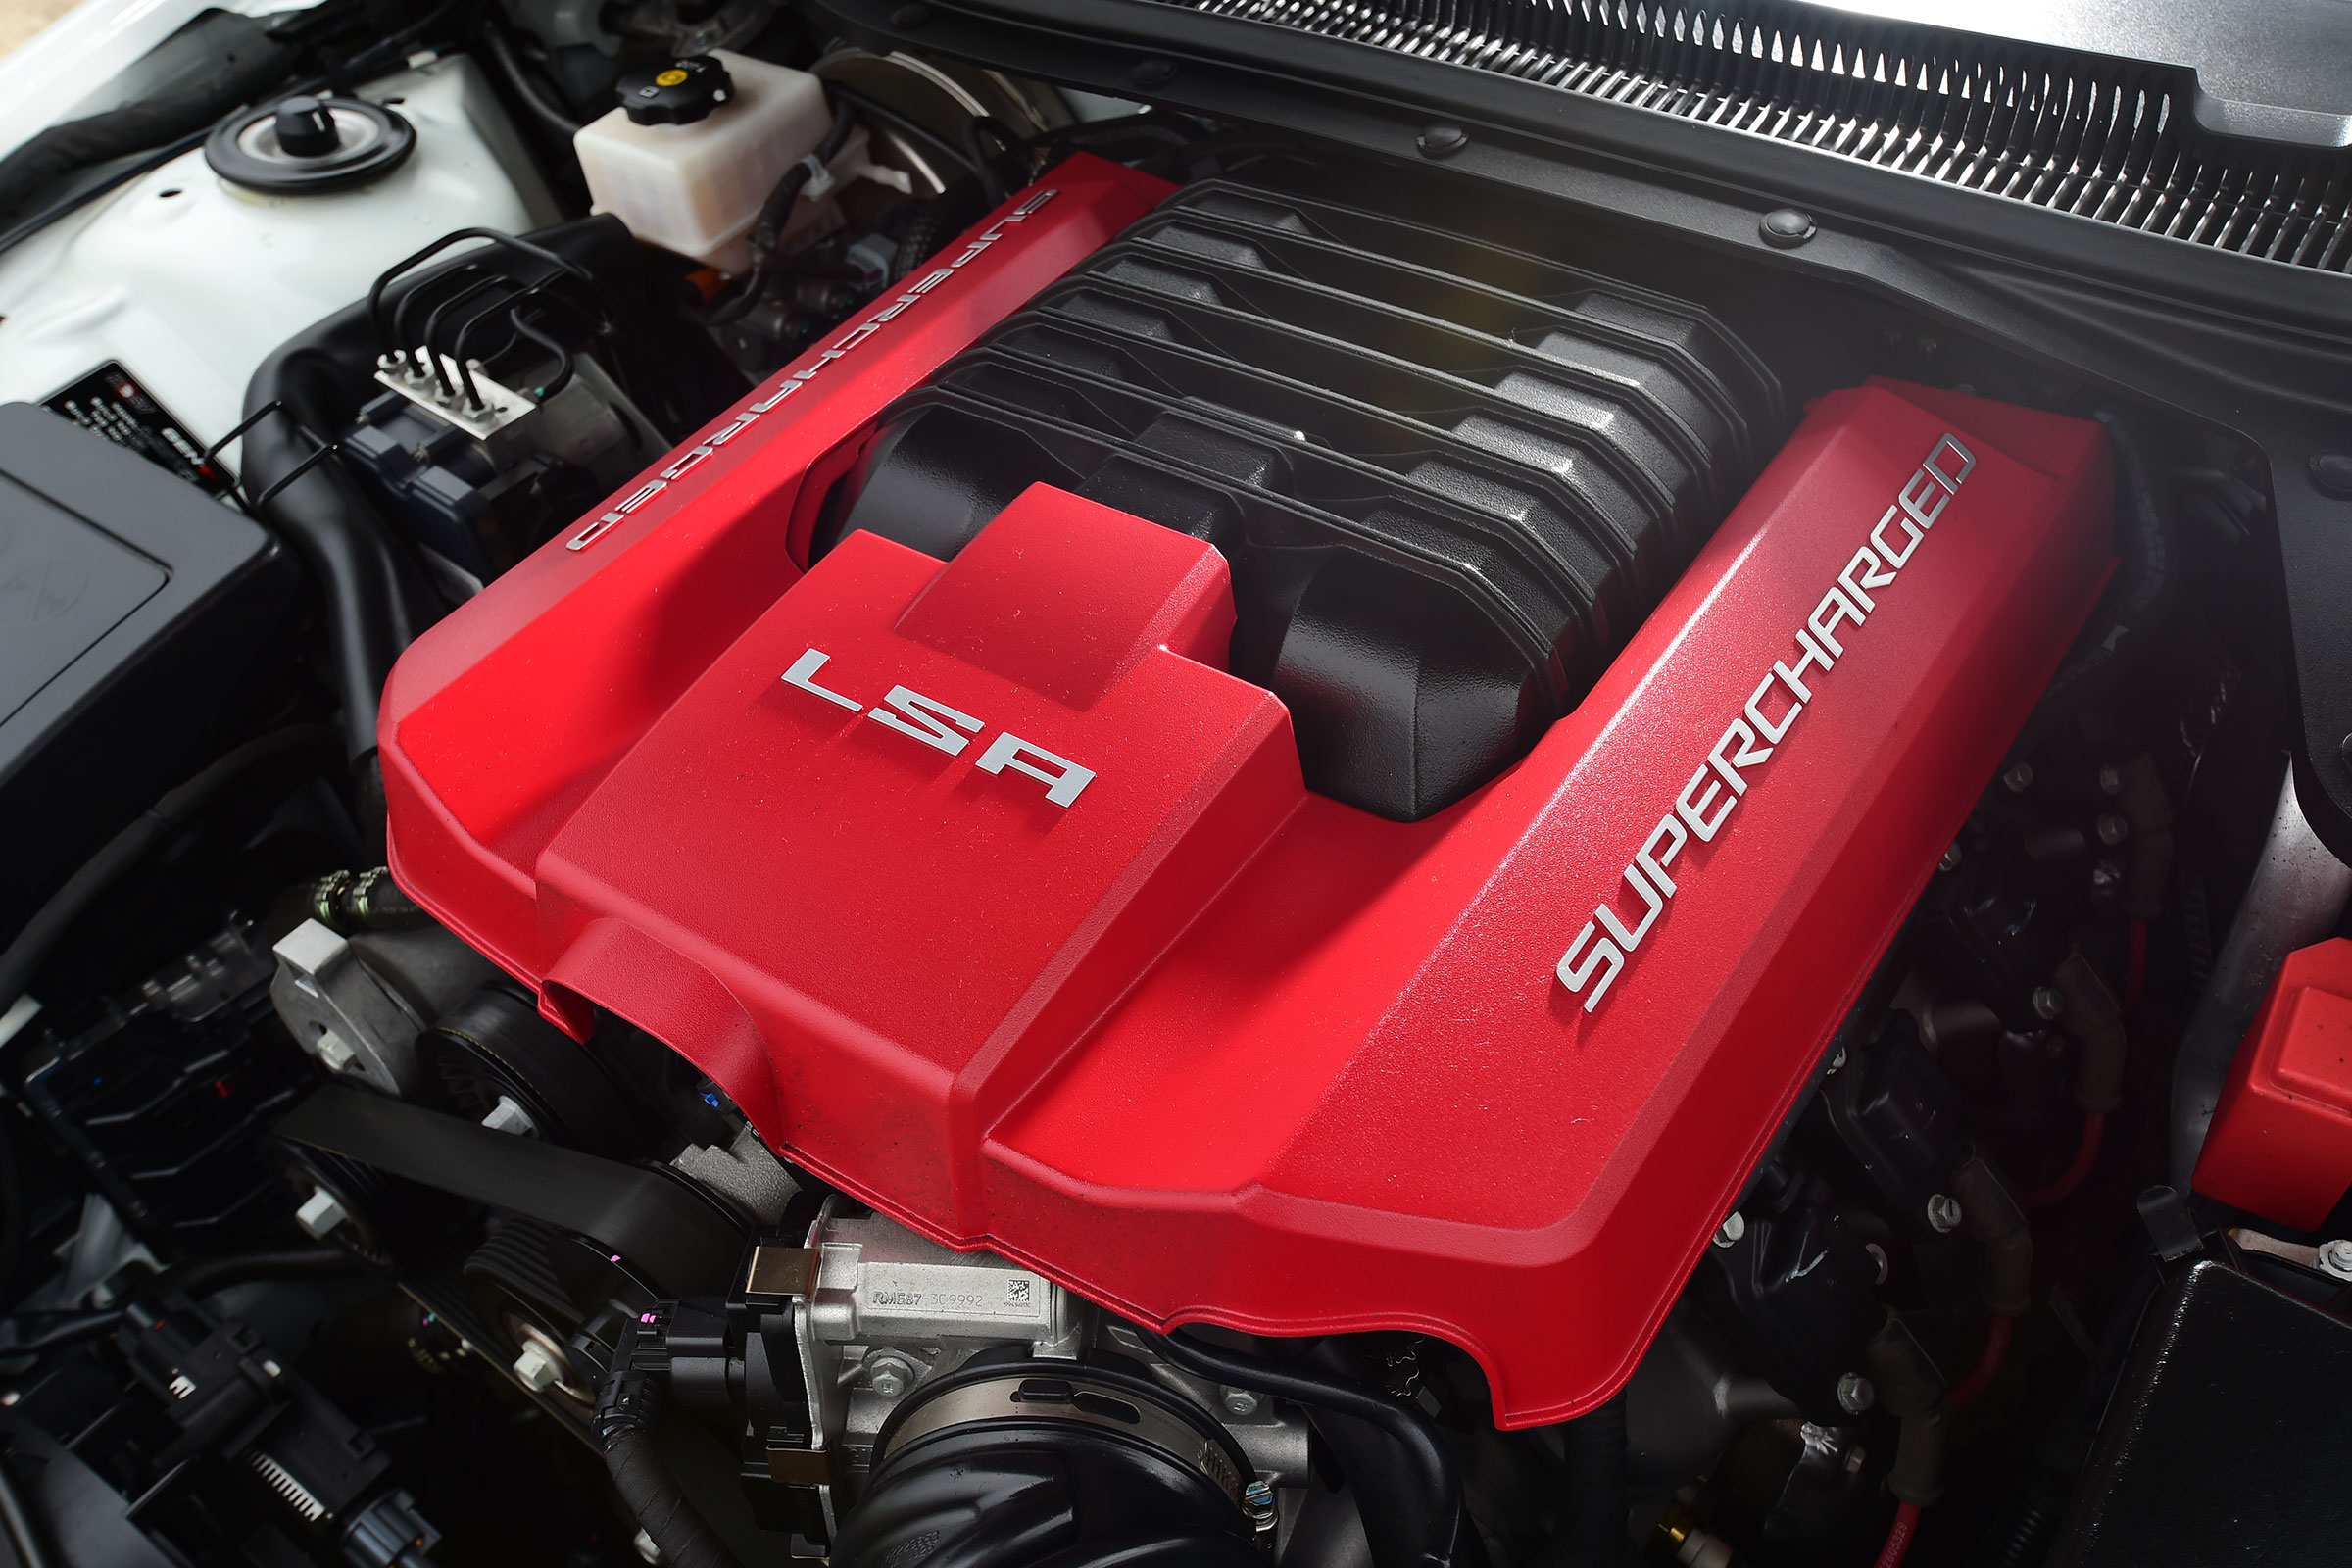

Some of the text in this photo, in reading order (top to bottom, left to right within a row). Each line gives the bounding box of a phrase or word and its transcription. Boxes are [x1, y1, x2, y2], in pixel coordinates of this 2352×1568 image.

[566, 189, 1057, 551] SUPERCHARGED
[781, 648, 1096, 808] LSA
[1556, 432, 1977, 1013] SUPERCHARGED
[1879, 1521, 1907, 1568] 2605329
